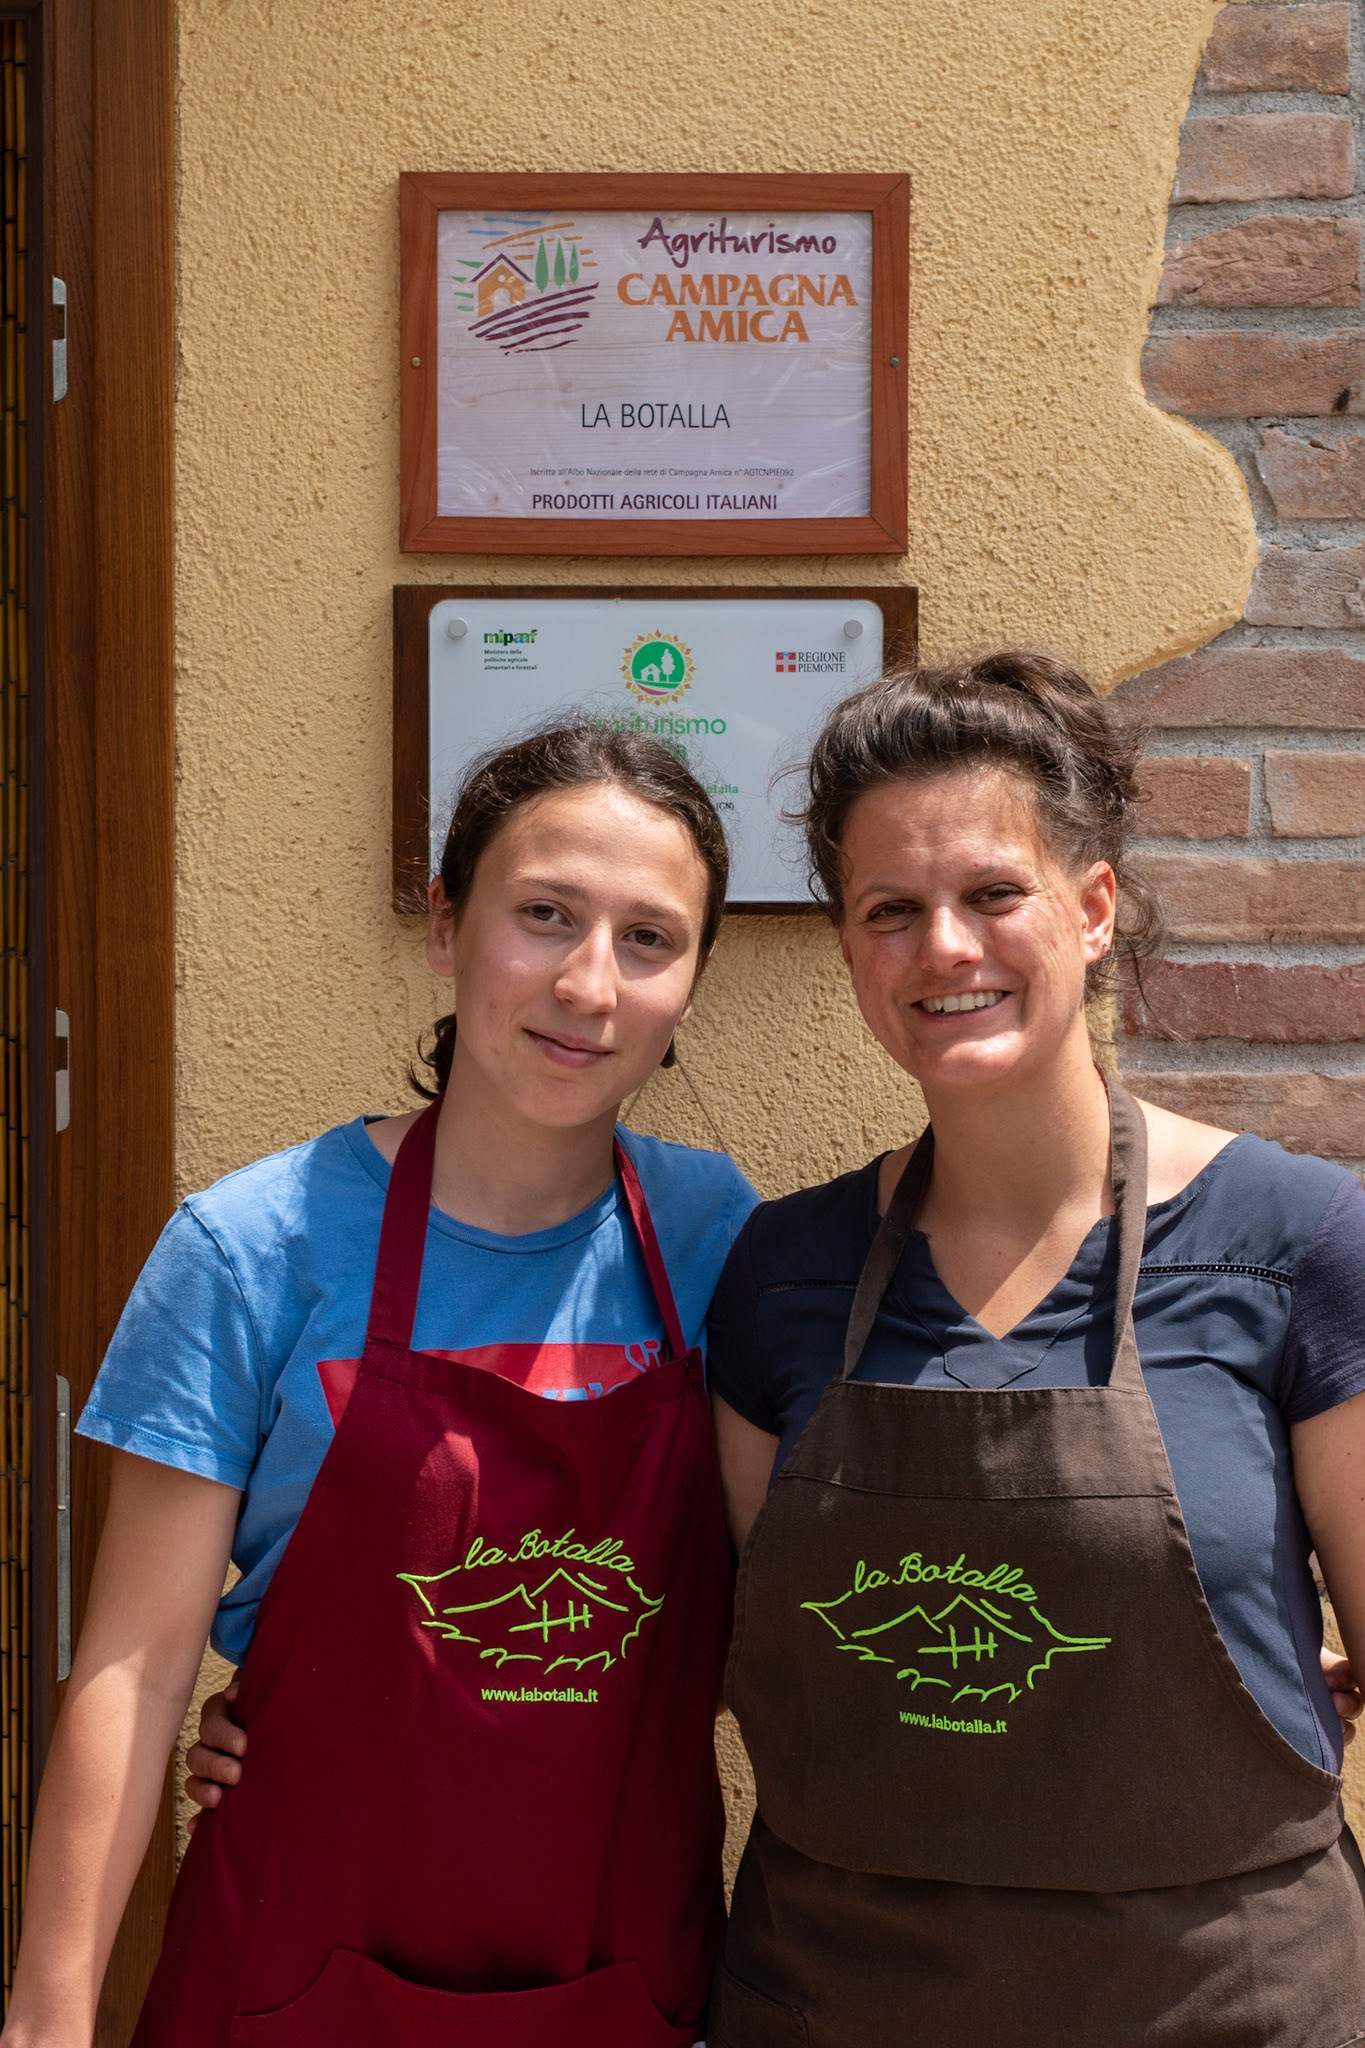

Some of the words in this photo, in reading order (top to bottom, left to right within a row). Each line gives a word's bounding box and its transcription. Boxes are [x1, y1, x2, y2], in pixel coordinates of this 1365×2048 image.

[638, 218, 836, 267] Agriturismo
[617, 273, 858, 306] CAMPAGNA
[665, 310, 811, 342] AMICA
[581, 404, 611, 428] LA
[621, 403, 731, 428] BOTALLA
[530, 468, 556, 476] Iscritta
[557, 467, 584, 476] all'Albo
[586, 468, 622, 476] Nazionale
[624, 467, 641, 476] della
[659, 467, 667, 476] di
[668, 468, 708, 478] Campagna
[709, 468, 732, 477] Amica
[532, 494, 614, 510] PRODOTTI
[620, 494, 700, 510] AGRICOLI
[706, 494, 778, 510] ITALIANI
[798, 652, 846, 662] REGIONE
[798, 664, 846, 673] PIEMONTE
[700, 783, 739, 793] otalla
[716, 802, 735, 811] (CN)
[465, 1537, 507, 1569] la
[508, 1528, 635, 1572] Botalla
[854, 1560, 889, 1593] la
[892, 1552, 1038, 1601] Botalla
[481, 1688, 599, 1702] www.labotalla.it
[899, 1711, 1008, 1734] www.labotalla.it
